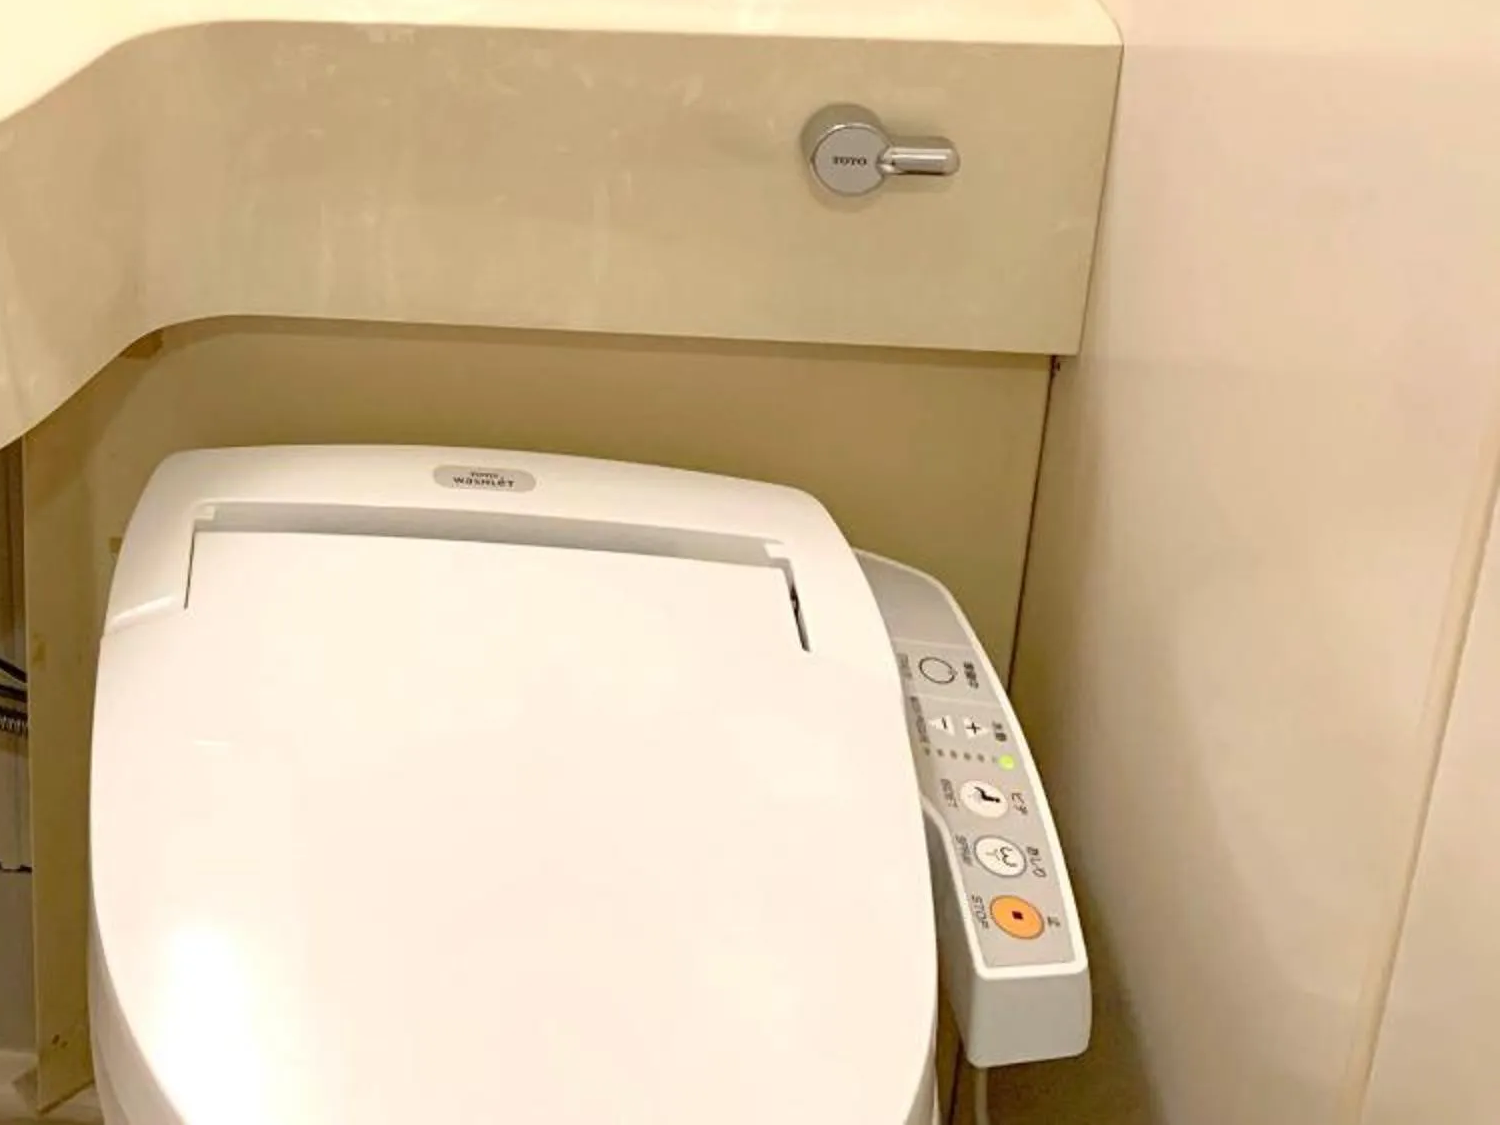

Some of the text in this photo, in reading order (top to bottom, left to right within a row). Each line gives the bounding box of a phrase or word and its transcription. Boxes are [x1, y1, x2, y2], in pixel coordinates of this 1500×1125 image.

[832, 155, 868, 166] TOTO
[1027, 846, 1047, 878] おしり
[971, 894, 990, 930] STOP
